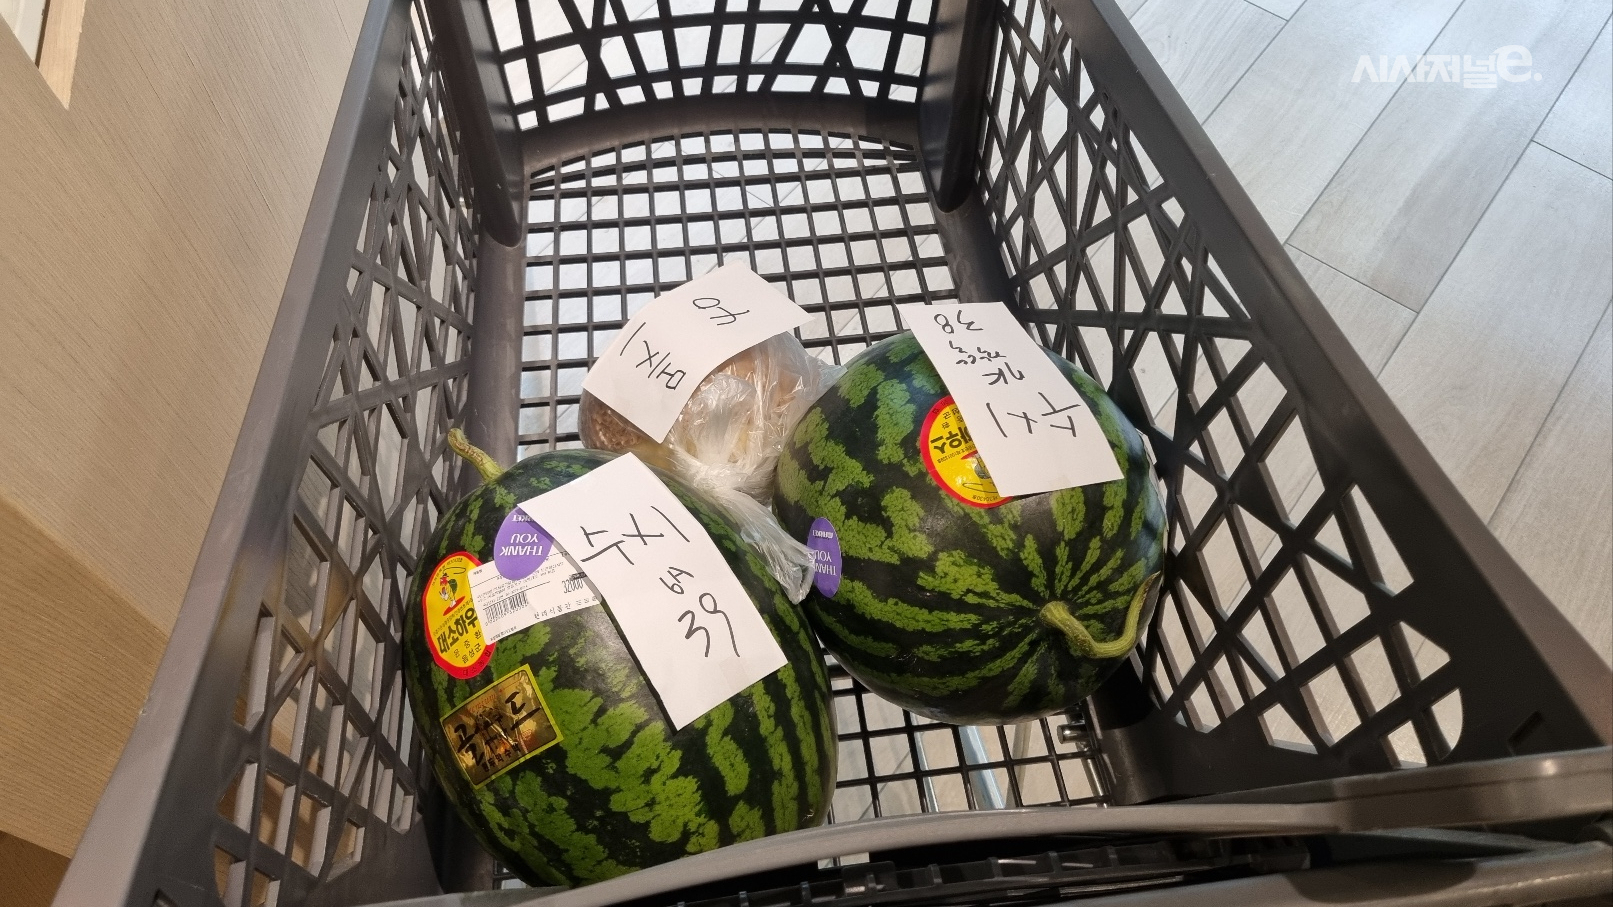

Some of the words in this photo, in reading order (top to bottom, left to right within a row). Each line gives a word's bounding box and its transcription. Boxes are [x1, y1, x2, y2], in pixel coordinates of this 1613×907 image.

[692, 297, 750, 326] 40
[933, 309, 984, 335] 38
[499, 545, 544, 557] THANK
[510, 533, 539, 544] YOU
[814, 562, 837, 577] THAN
[436, 607, 480, 653] 대소하우
[677, 592, 741, 658] 39
